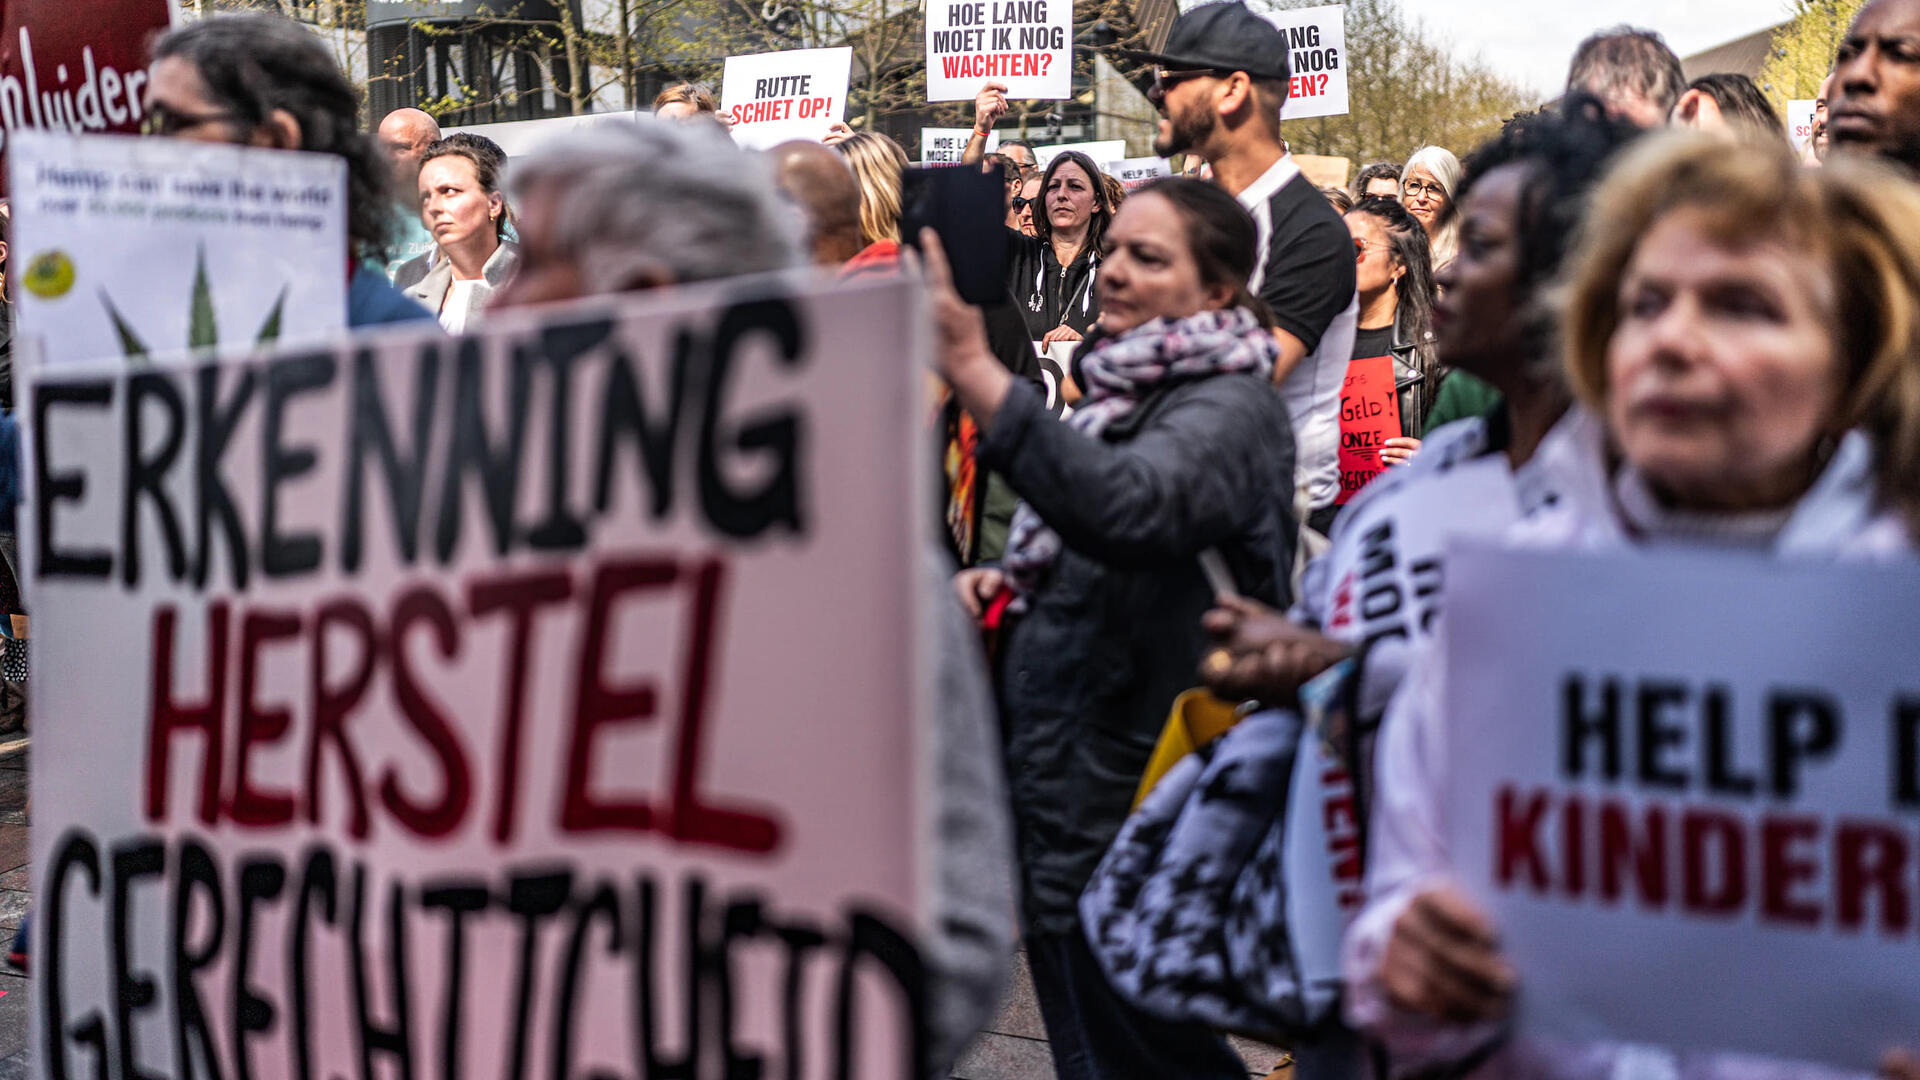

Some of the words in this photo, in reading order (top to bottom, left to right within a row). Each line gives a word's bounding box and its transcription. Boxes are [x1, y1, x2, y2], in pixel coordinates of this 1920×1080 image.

[948, 3, 985, 27] HOE
[992, 0, 1047, 24] LANG
[933, 28, 985, 53] MOET
[991, 27, 1012, 50] IK
[1019, 26, 1064, 50] NOG
[942, 53, 1053, 79] WACHTEN?
[1294, 48, 1338, 73] NOG
[755, 75, 811, 99] RUTTE
[732, 99, 793, 125] SCHIET
[798, 97, 832, 119] OP!
[926, 150, 955, 162] MOET
[934, 137, 953, 149] HOE
[1121, 168, 1143, 180] HELP
[33, 297, 811, 590] ERKENNING
[1341, 430, 1382, 448] ONZE
[146, 562, 786, 856] HERSTEL
[1561, 671, 1843, 799] HELP
[1493, 781, 1920, 937] KINDER
